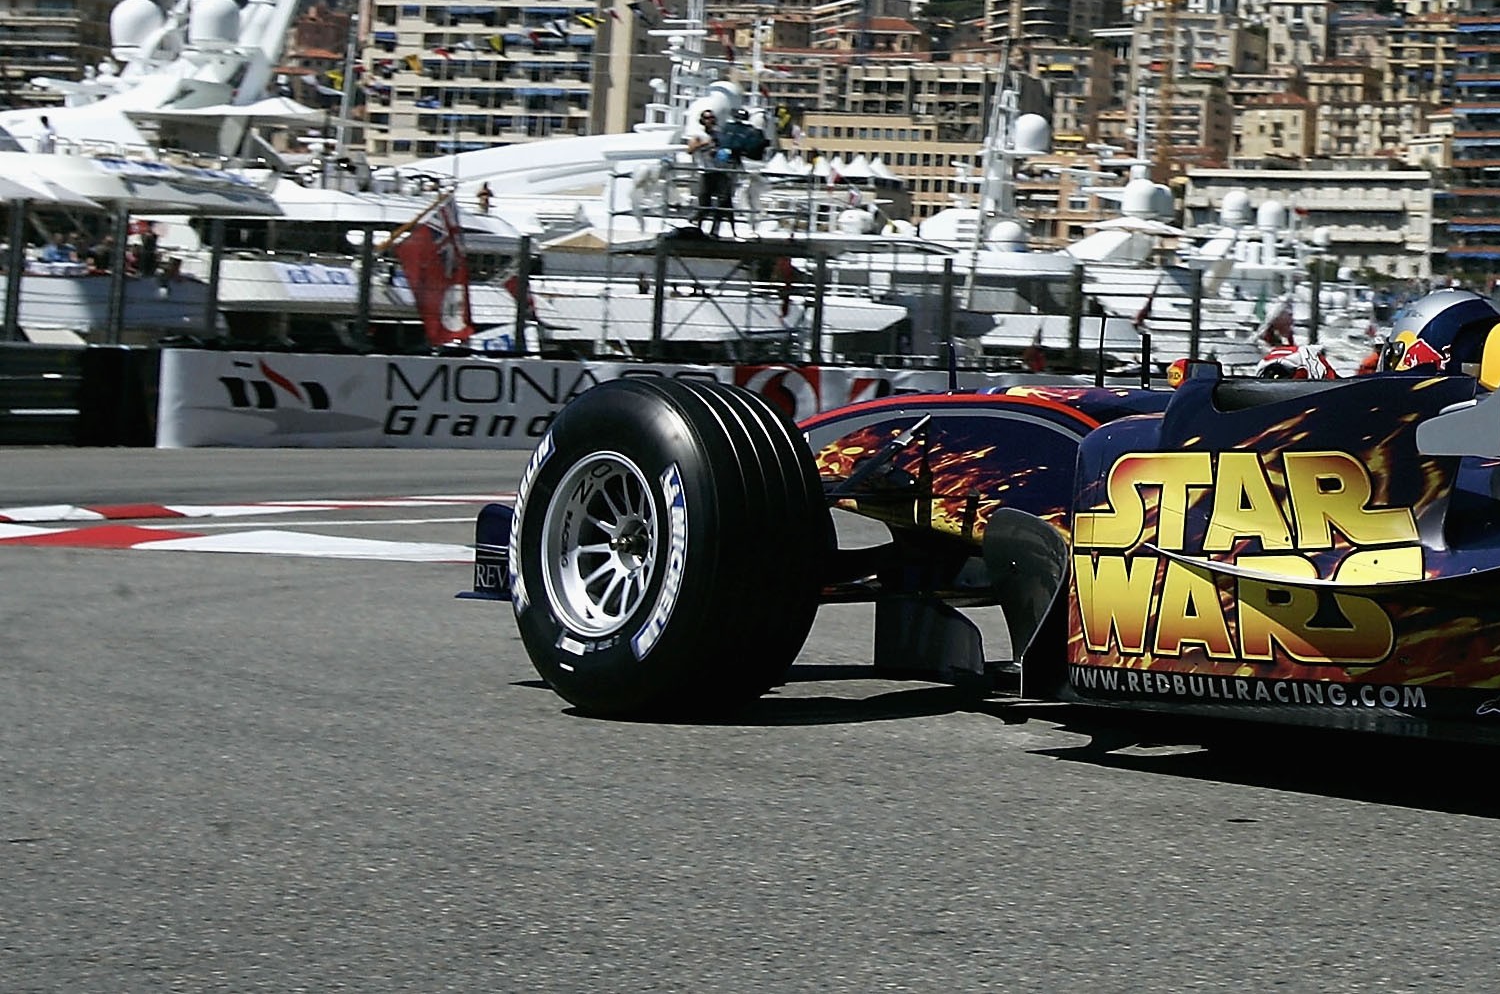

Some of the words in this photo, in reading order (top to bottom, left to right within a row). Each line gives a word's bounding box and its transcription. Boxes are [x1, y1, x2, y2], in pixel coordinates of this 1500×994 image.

[383, 405, 556, 438] Grand
[1073, 450, 1422, 551] STAR
[636, 505, 687, 656] MICHELIN
[1073, 546, 1424, 664] WARS
[1068, 666, 1428, 708] WWW.REDBULLRACING.COM
